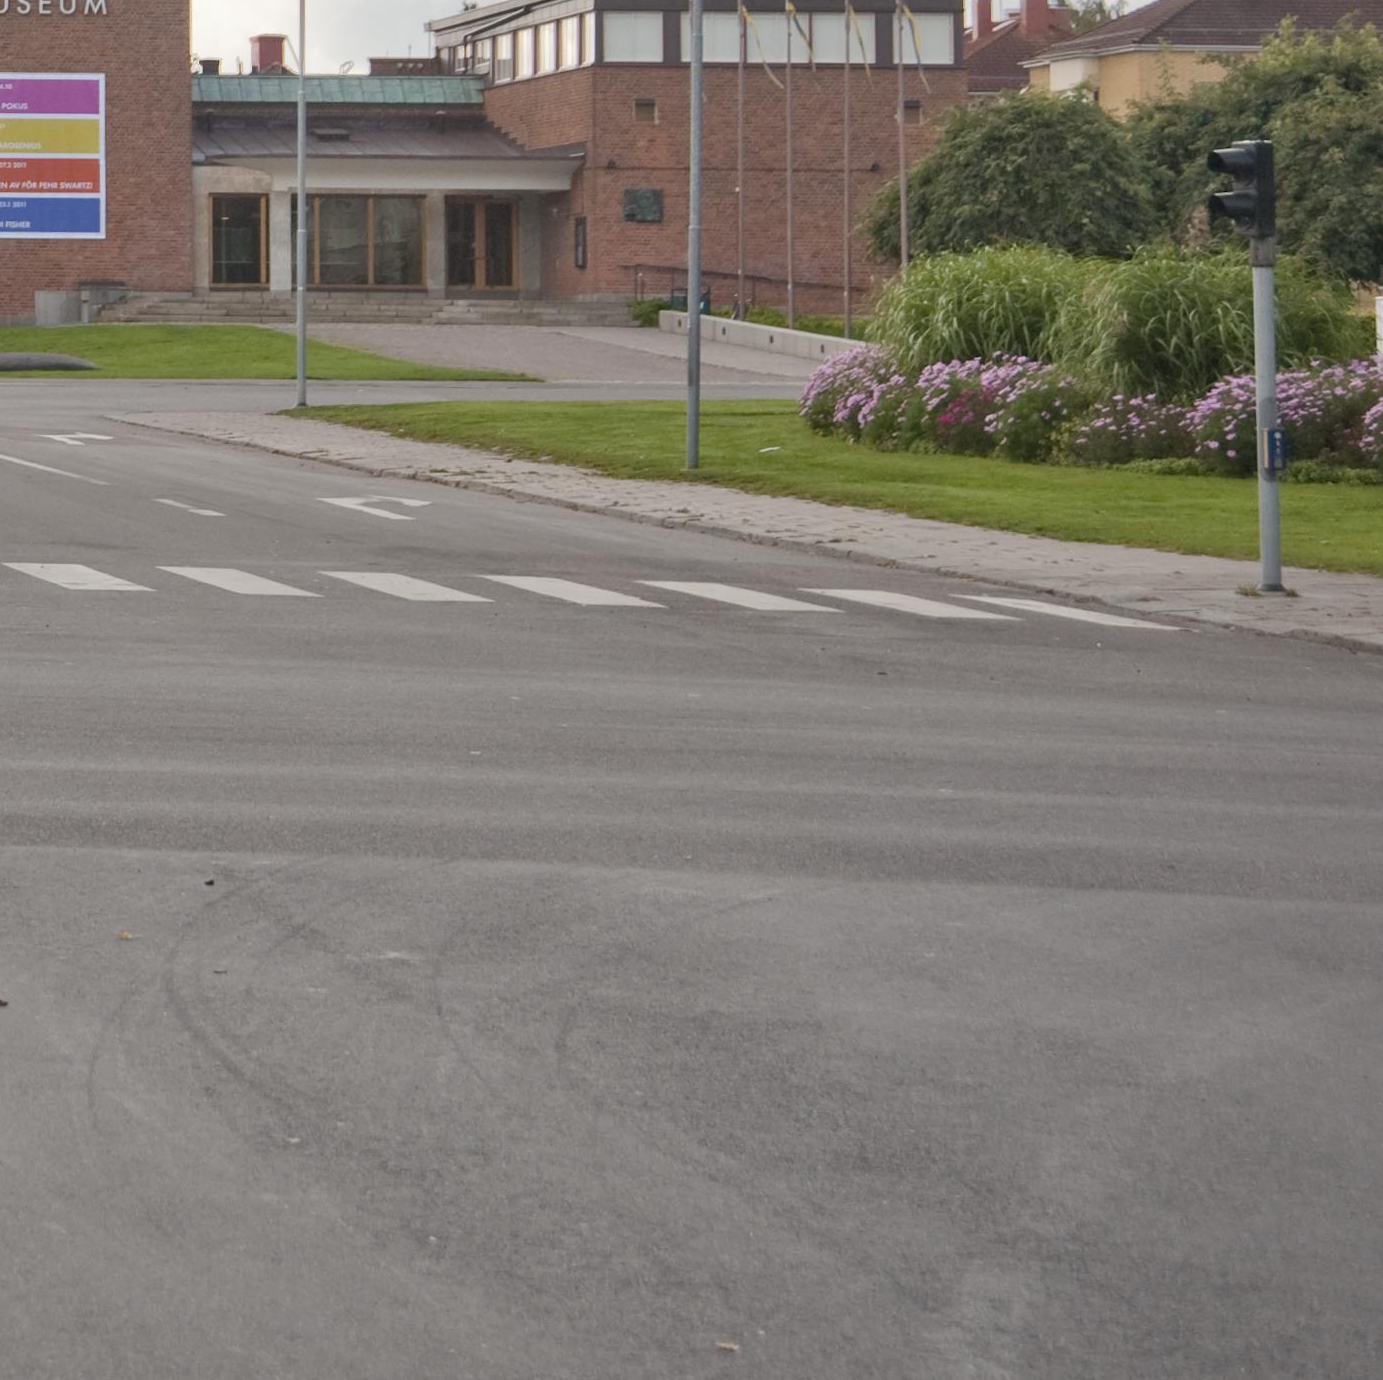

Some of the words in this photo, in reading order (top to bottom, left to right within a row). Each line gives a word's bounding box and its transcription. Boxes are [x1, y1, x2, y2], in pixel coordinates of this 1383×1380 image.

[1, 102, 28, 110] POKUS
[9, 181, 19, 189] AV
[21, 180, 36, 189] FÖR
